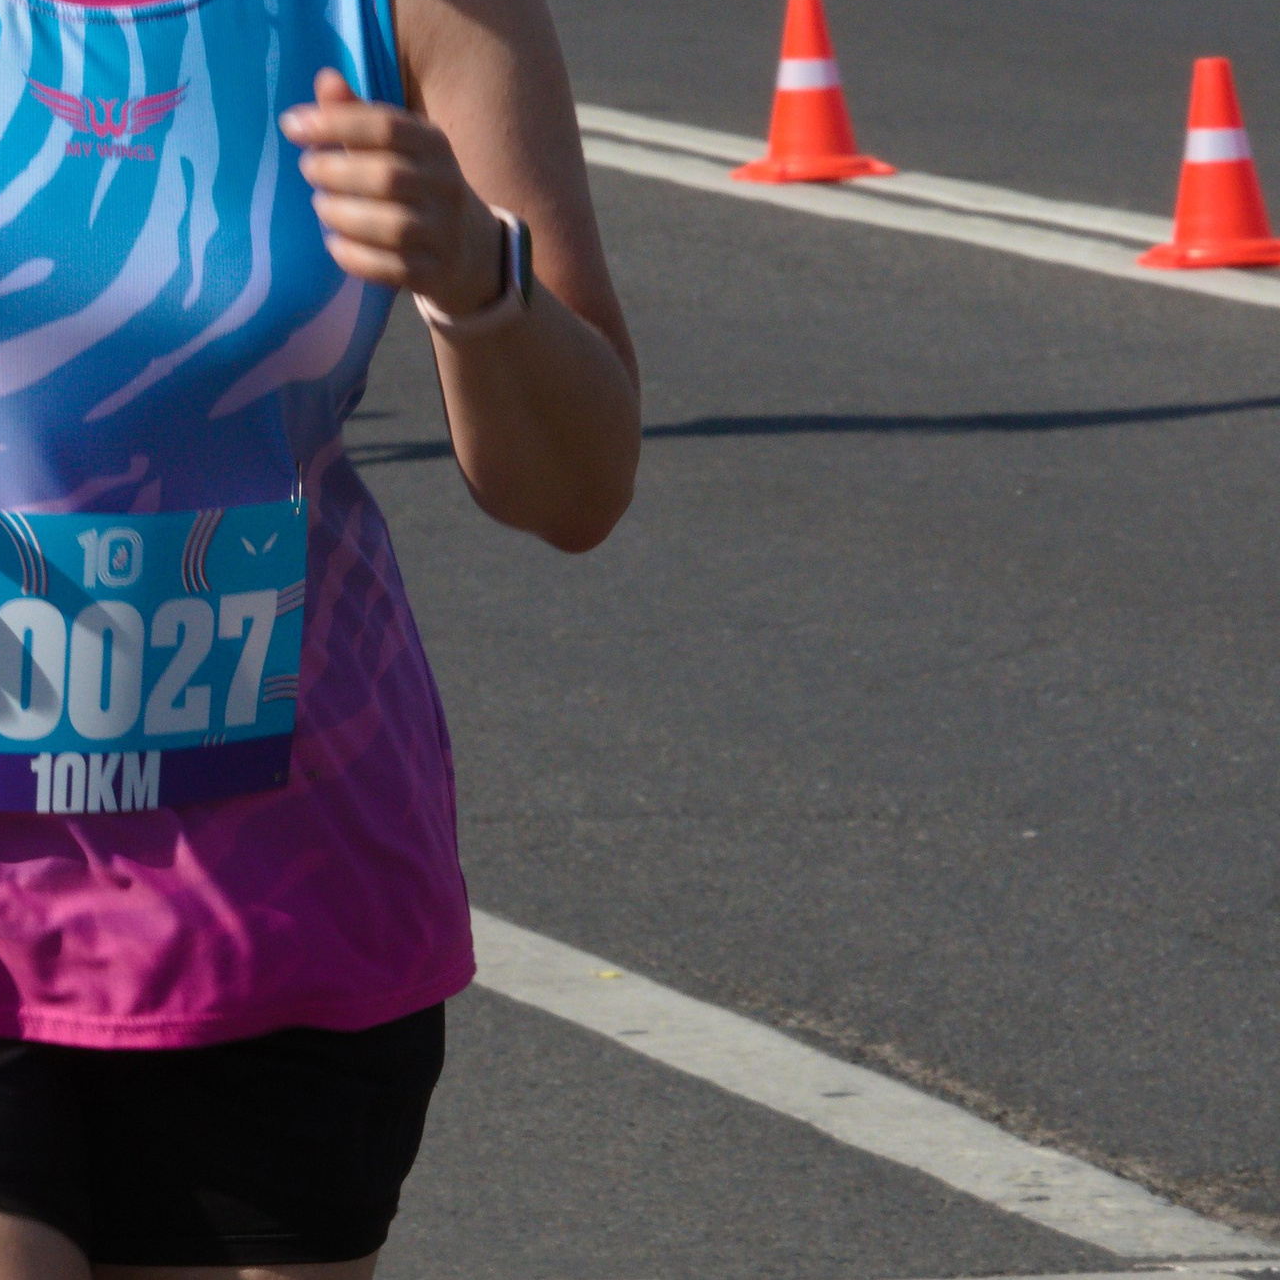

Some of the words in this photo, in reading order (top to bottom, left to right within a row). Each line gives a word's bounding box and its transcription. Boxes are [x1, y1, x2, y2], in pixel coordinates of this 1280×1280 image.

[65, 140, 92, 158] MY
[97, 141, 156, 161] WINGS
[76, 527, 144, 589] 10
[30, 749, 162, 816] 10KM
